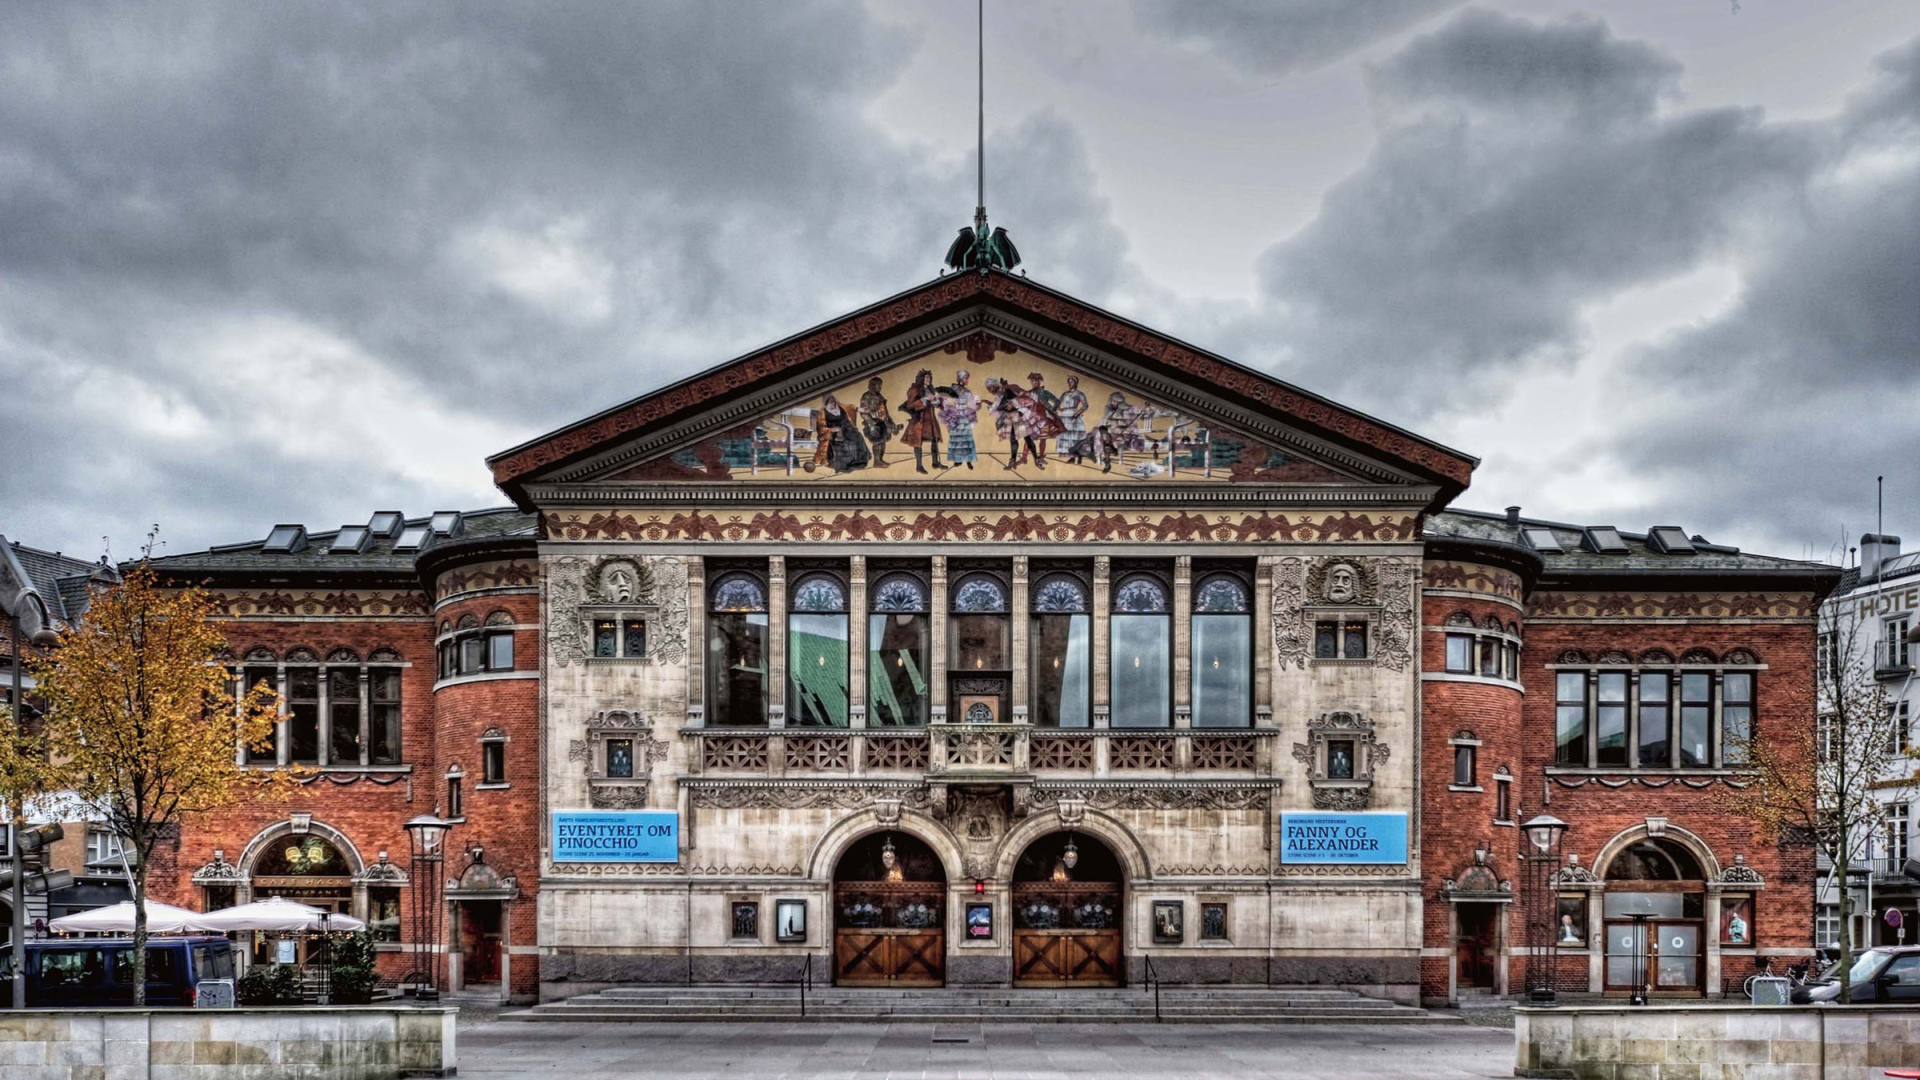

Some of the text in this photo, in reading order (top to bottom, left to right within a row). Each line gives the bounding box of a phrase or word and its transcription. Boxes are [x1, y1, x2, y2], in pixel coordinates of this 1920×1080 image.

[558, 825, 671, 837] EVENTYRET OM
[1287, 826, 1367, 838] FANNY OG
[558, 837, 638, 849] PINOCCHIO
[1287, 839, 1379, 851] ALEXANDER
